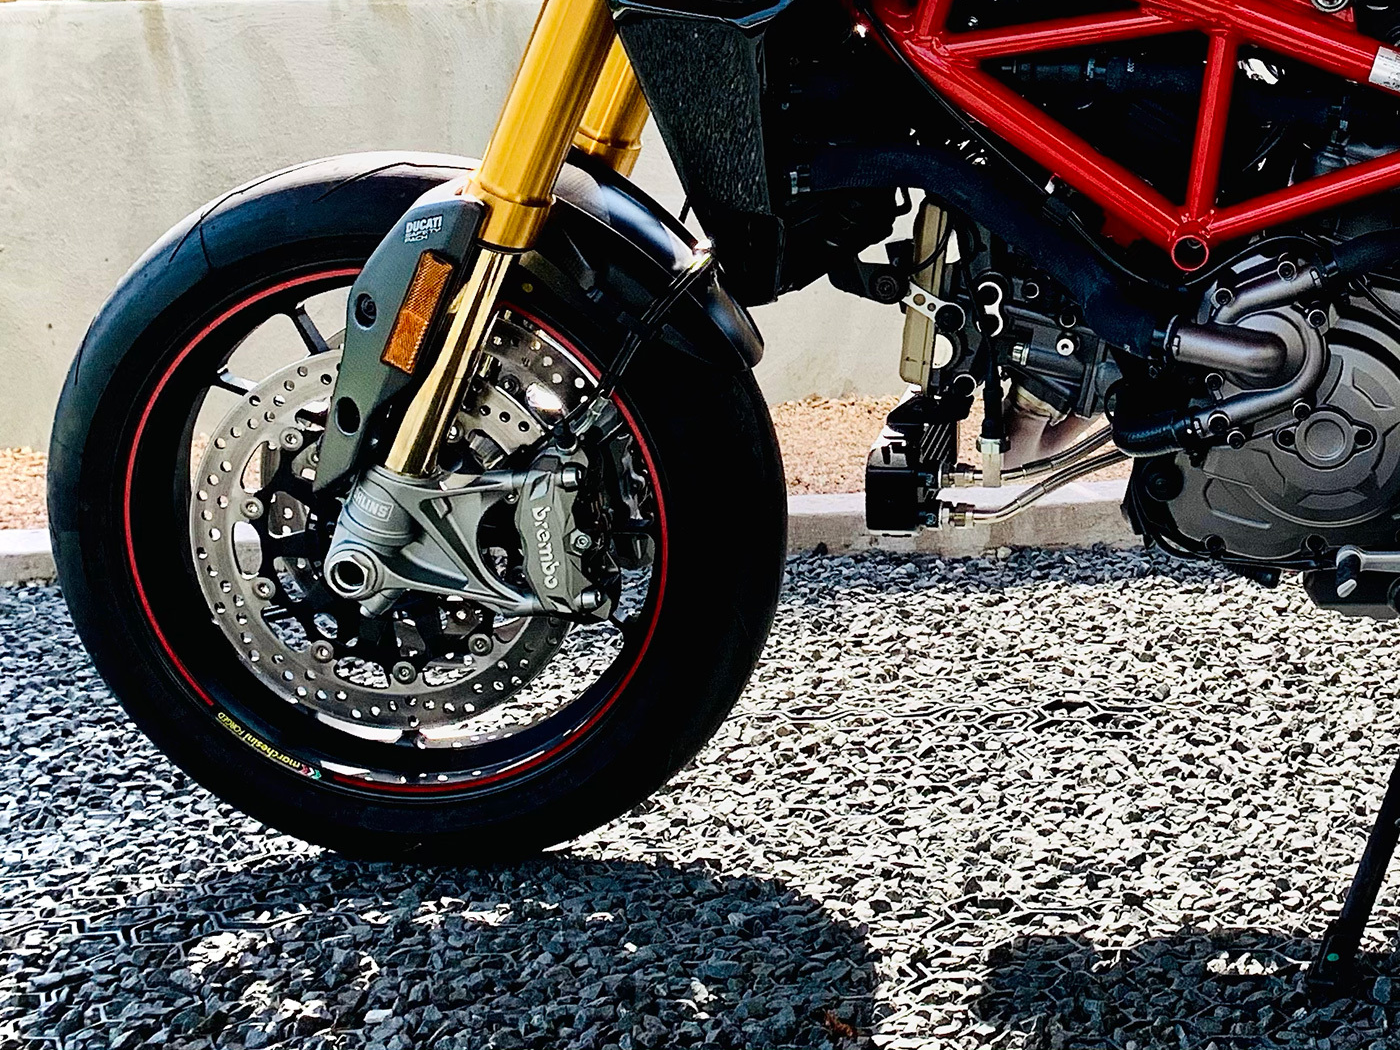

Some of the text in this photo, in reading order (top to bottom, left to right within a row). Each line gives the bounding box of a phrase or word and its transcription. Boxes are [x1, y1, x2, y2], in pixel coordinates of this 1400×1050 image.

[405, 215, 443, 233] DUCATI
[352, 490, 390, 518] HLINS
[532, 506, 560, 589] brembo
[217, 712, 245, 736] FORGED
